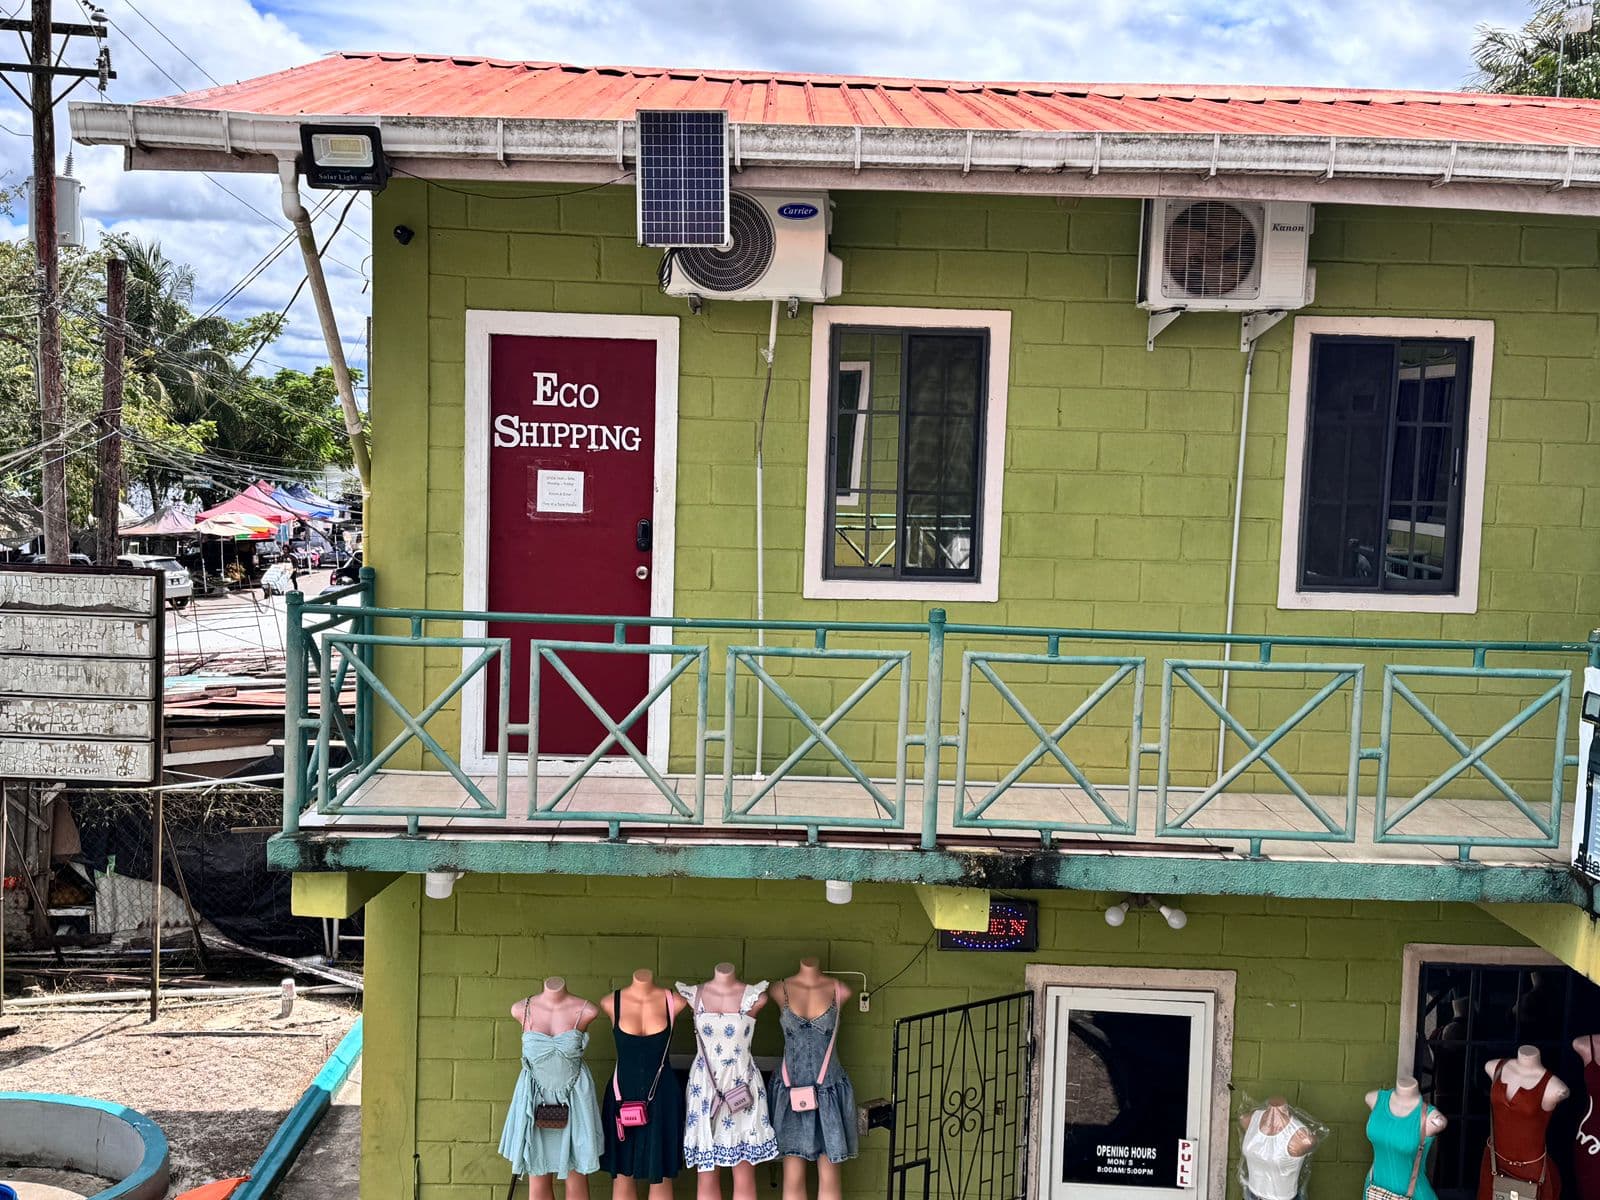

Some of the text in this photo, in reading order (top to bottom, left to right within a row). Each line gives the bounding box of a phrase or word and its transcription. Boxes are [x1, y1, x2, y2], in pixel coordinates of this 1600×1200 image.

[338, 174, 358, 182] Light
[783, 207, 813, 215] Carrier
[1272, 223, 1305, 232] Kanon
[493, 414, 642, 452] SHIPPING
[1096, 1144, 1157, 1160] OPENING HOURS
[1179, 1142, 1192, 1185] PULL
